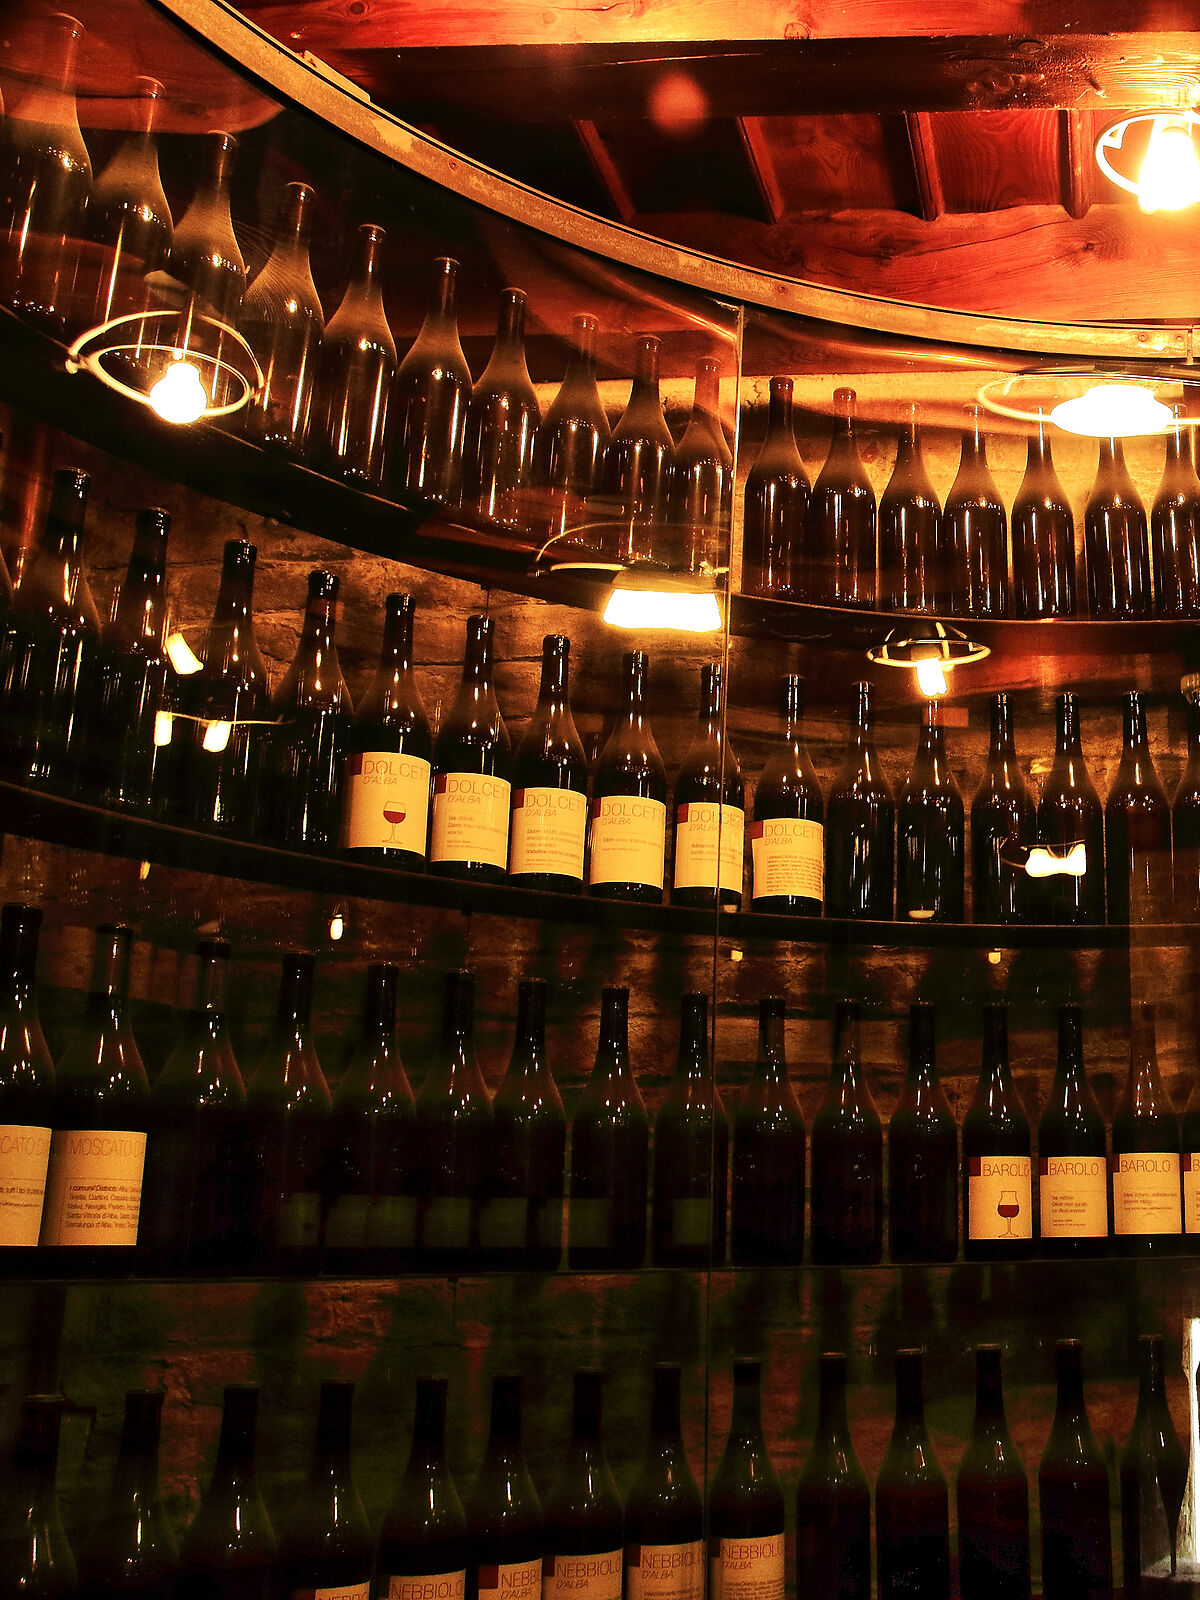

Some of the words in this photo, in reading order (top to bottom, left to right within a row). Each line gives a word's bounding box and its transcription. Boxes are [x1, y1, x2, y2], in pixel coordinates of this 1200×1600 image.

[982, 1163, 1030, 1177] BAROLO
[1049, 1162, 1099, 1176] BAROLO
[1120, 1159, 1171, 1173] BAROLO
[722, 1542, 783, 1560] NEBBIOLO
[556, 1557, 621, 1579] NEBBIOLO
